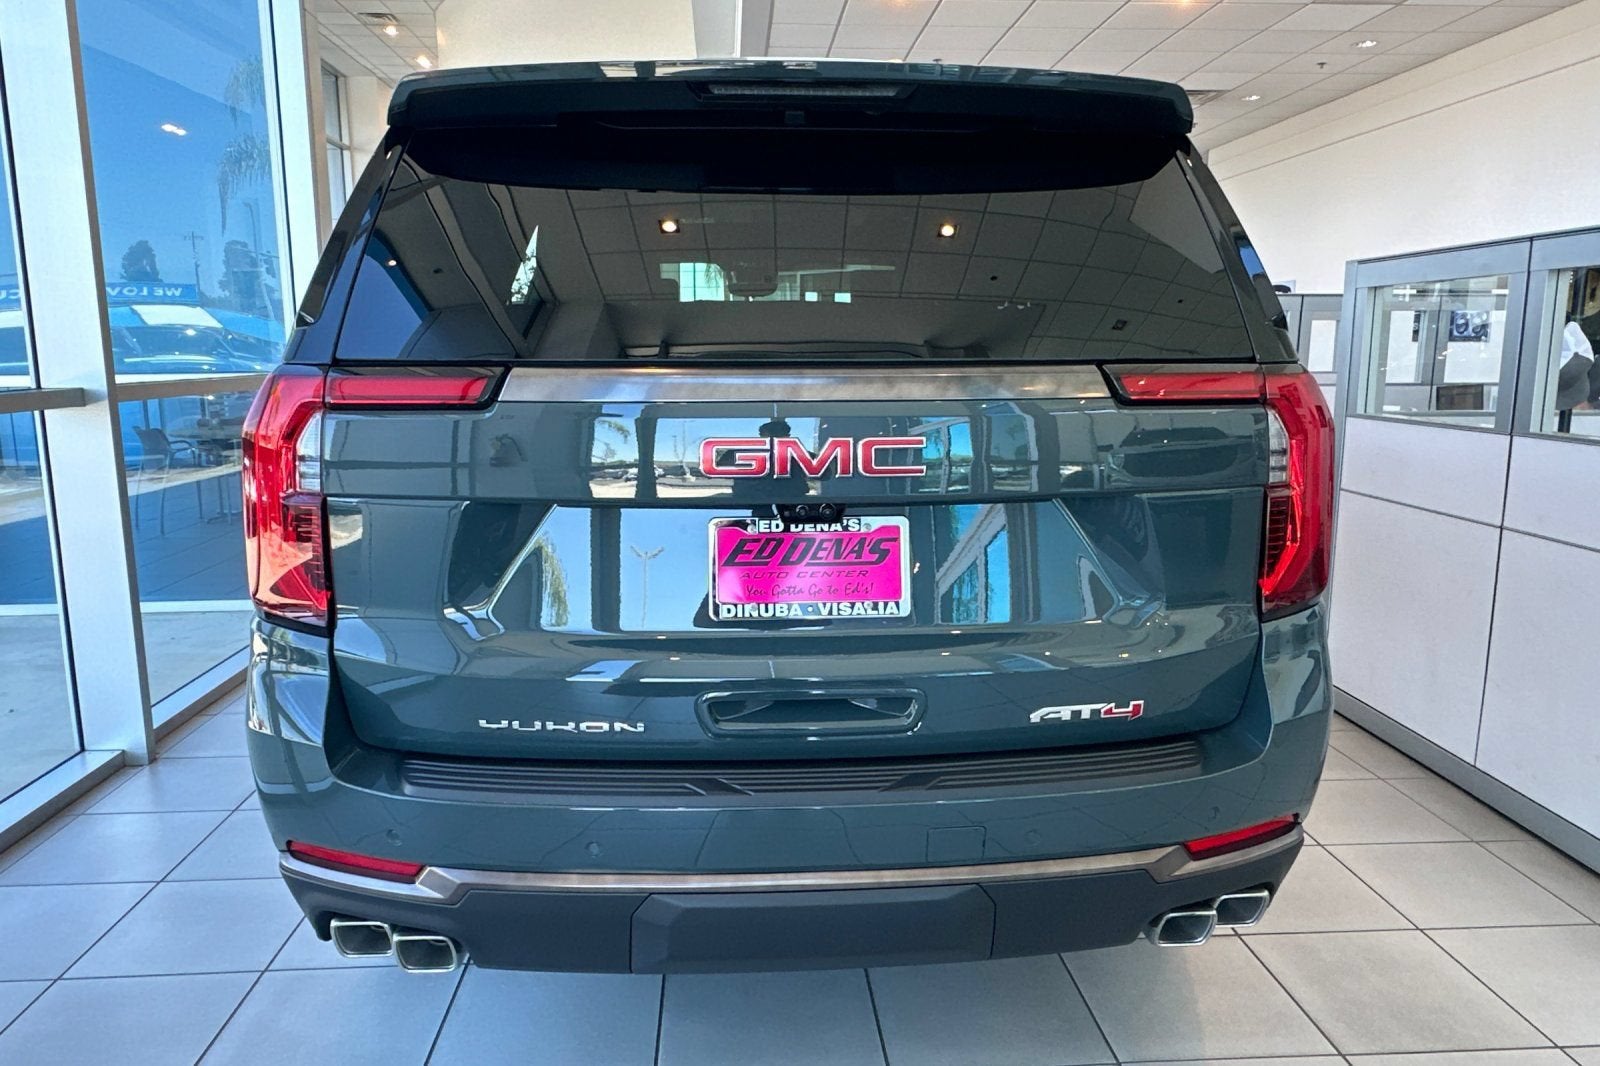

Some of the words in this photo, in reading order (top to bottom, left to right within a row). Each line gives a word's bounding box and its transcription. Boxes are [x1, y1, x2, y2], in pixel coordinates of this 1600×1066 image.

[700, 437, 926, 478] GMC
[759, 519, 785, 532] ED
[721, 537, 785, 566] ED
[777, 536, 899, 566] DENA'S
[740, 571, 789, 579] AUTO
[796, 570, 869, 579] CENTER
[746, 584, 767, 596] You
[771, 584, 804, 597] Gotta
[808, 583, 823, 597] Go
[827, 584, 839, 595] to
[722, 603, 804, 618] DINUBA
[818, 601, 900, 616] VISALIA
[1029, 700, 1145, 723] AT4
[478, 719, 645, 733] YUKON
